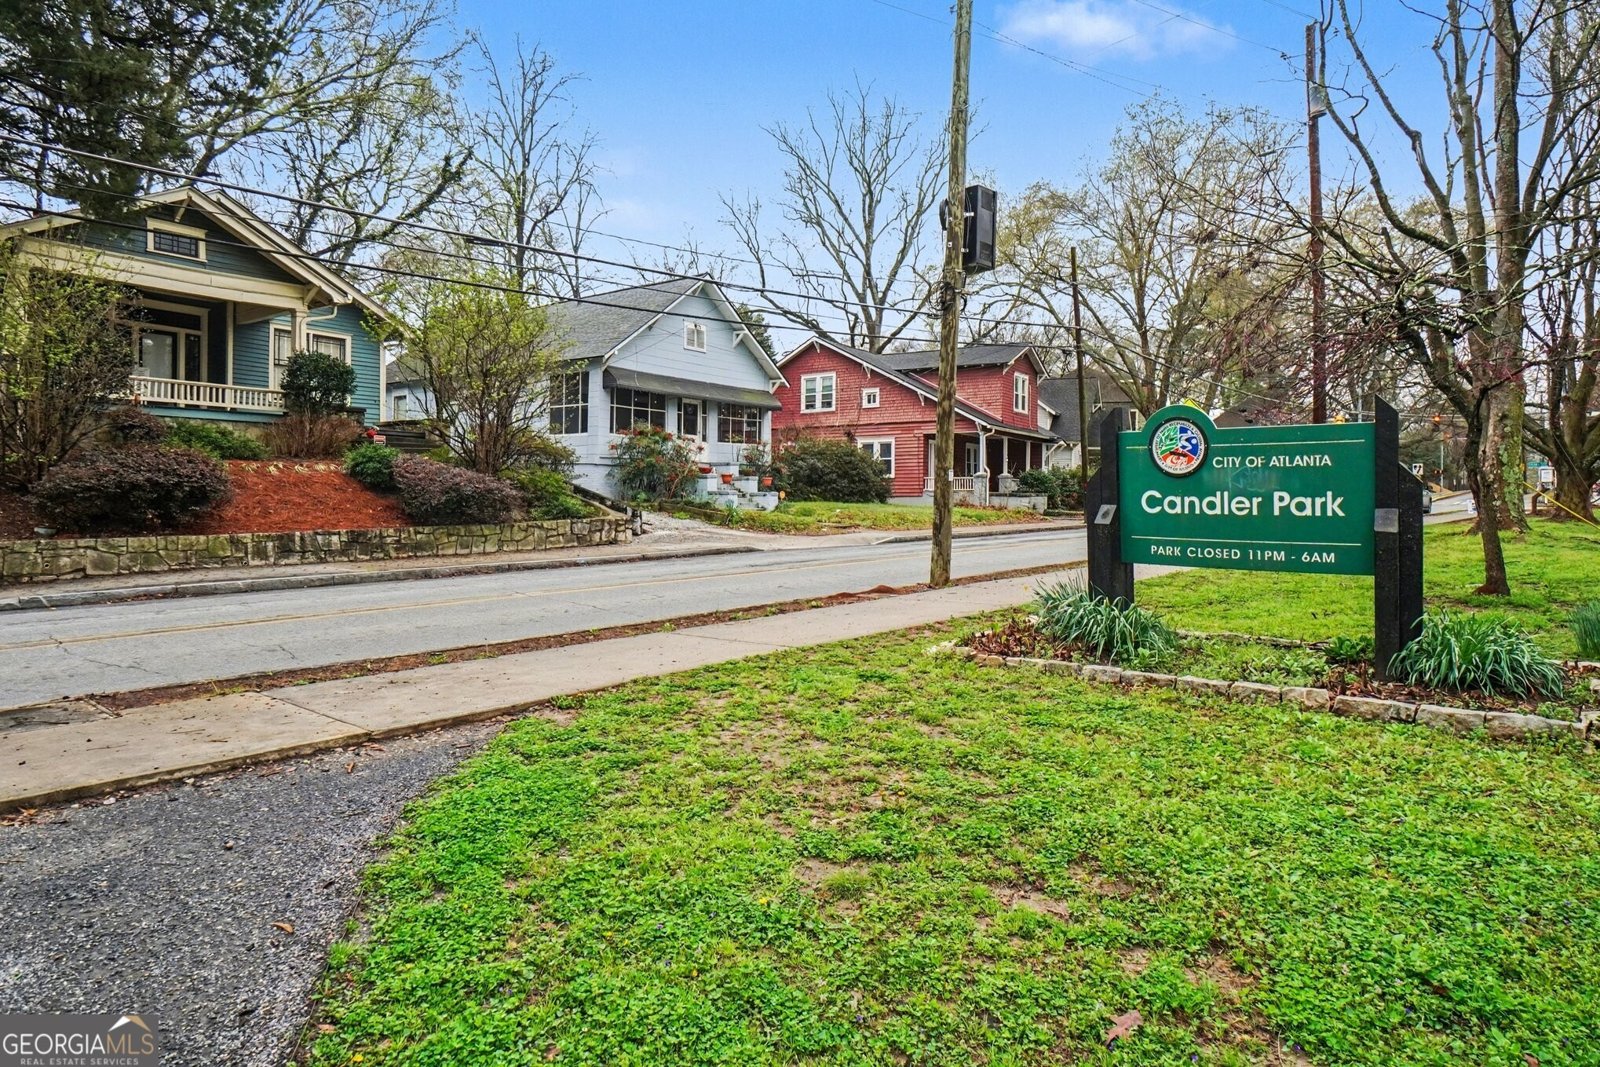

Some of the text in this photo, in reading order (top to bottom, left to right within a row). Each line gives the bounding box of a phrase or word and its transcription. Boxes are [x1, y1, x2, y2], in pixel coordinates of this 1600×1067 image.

[1212, 454, 1332, 469] CITY OF ATLANTA
[1140, 489, 1346, 517] Candler Park
[1150, 545, 1181, 557] PARK
[1186, 546, 1241, 560] CLOSED
[1248, 549, 1286, 562] 11PM
[1301, 550, 1336, 564] 6AM
